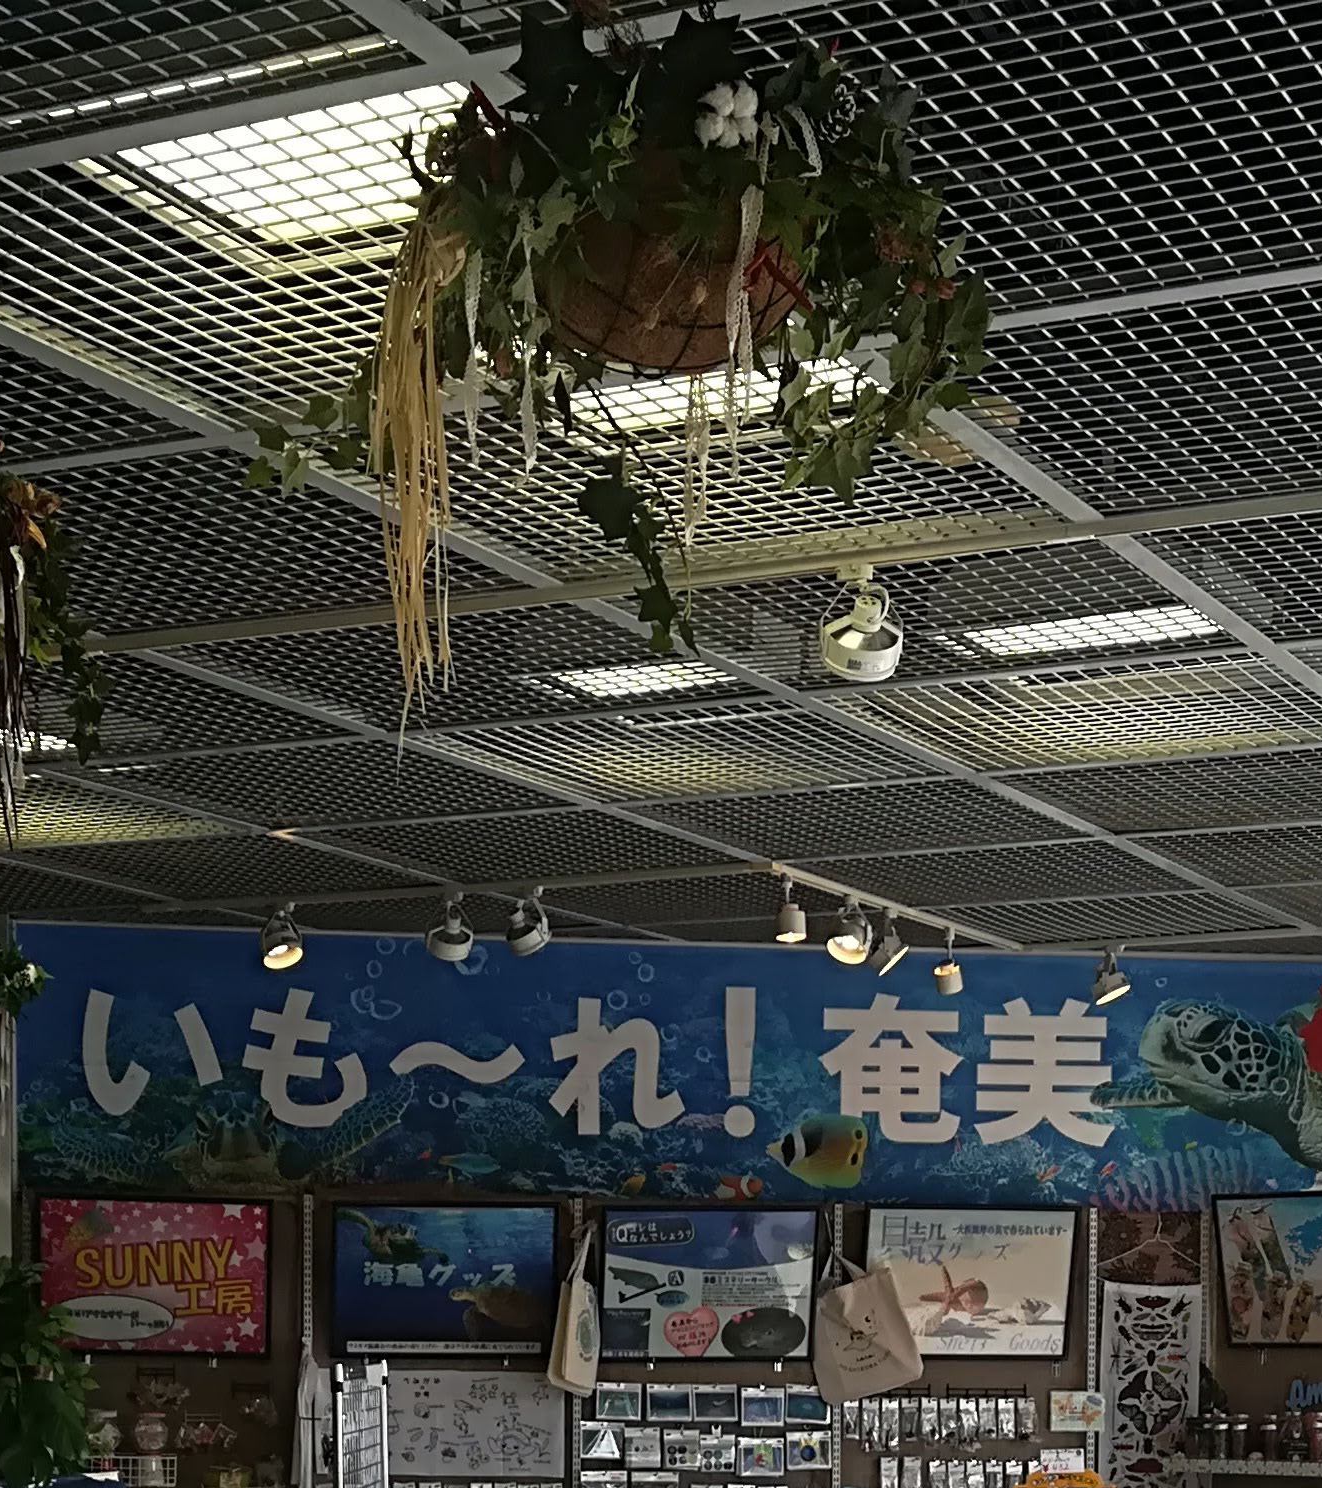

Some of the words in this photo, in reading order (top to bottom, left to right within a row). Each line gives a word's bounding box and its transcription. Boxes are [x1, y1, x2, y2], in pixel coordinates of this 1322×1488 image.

[75, 1237, 234, 1290] SUNNY
[363, 1260, 517, 1288] 海亀グッズ
[174, 1279, 254, 1318] 工房
[1008, 1333, 1061, 1355] Goods
